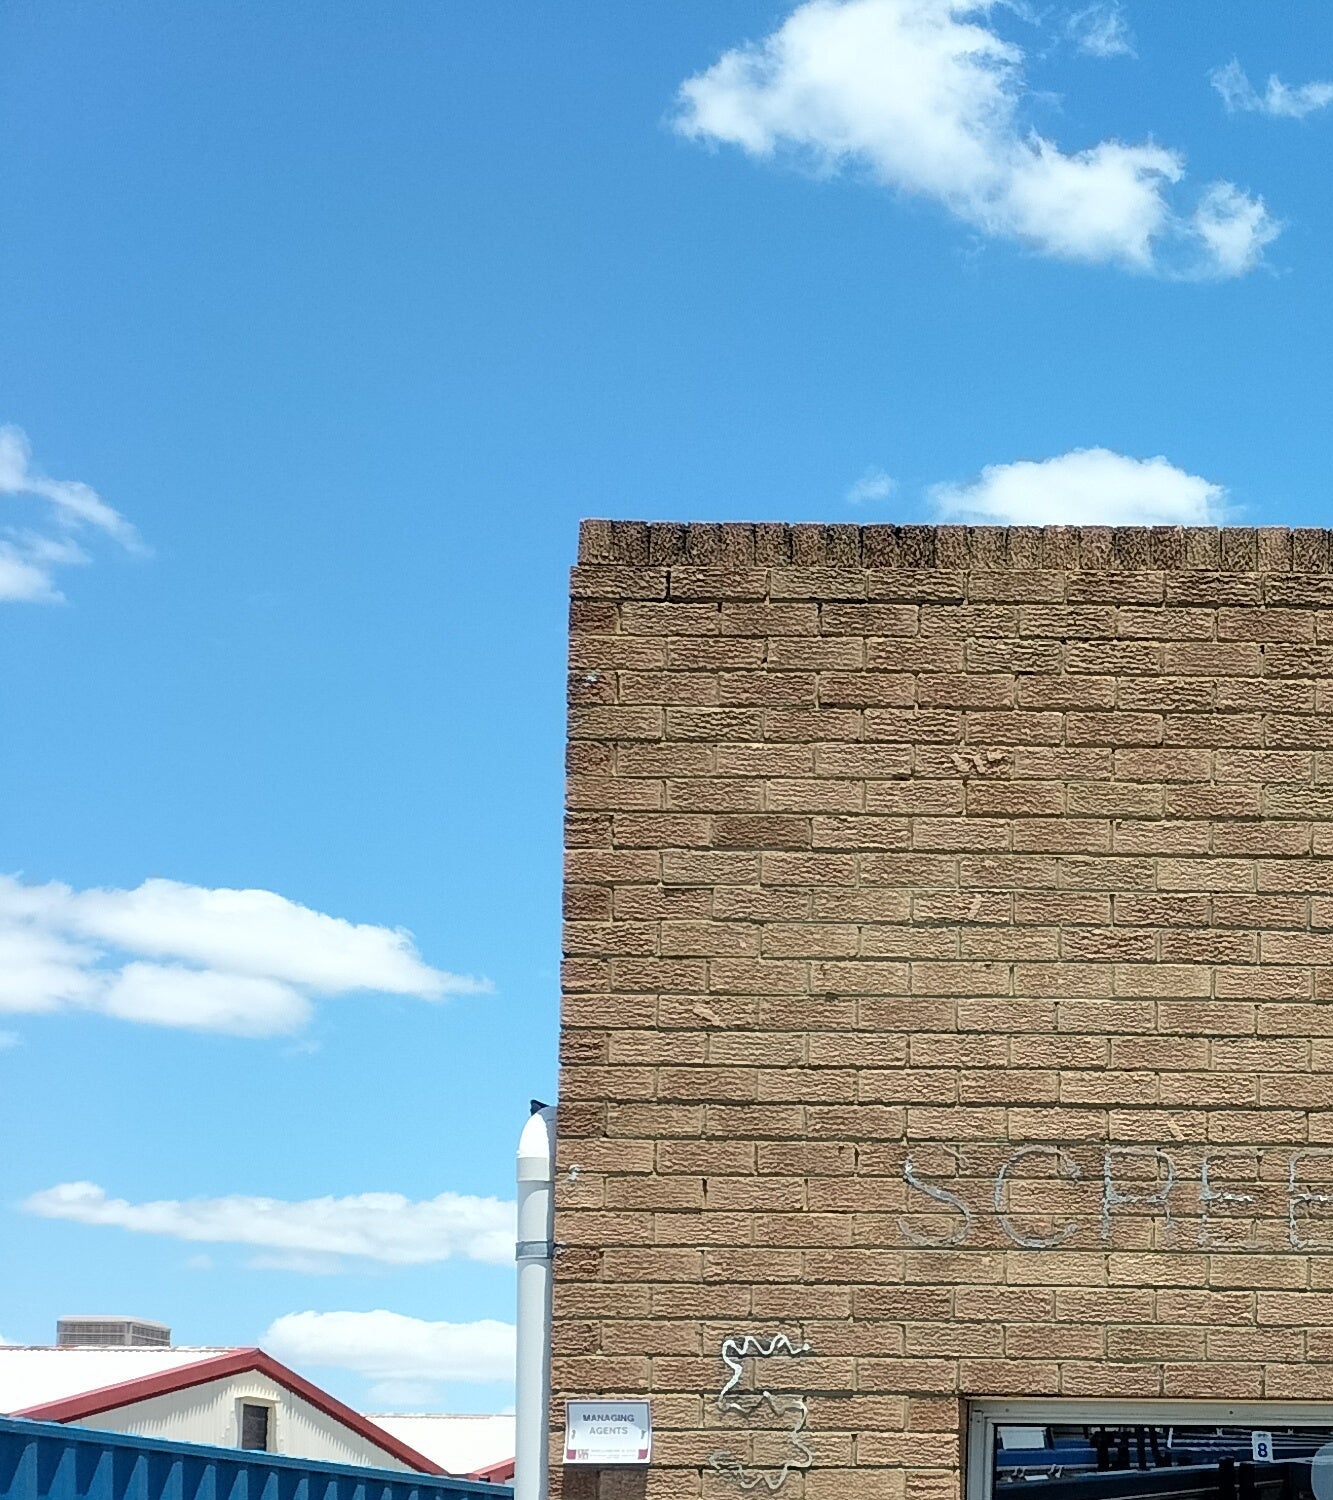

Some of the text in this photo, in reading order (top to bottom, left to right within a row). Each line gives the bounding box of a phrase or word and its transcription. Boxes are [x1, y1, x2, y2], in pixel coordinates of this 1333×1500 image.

[582, 1414, 635, 1422] MANAGING
[589, 1427, 629, 1435] AGENTS
[1256, 1442, 1268, 1458] 8
